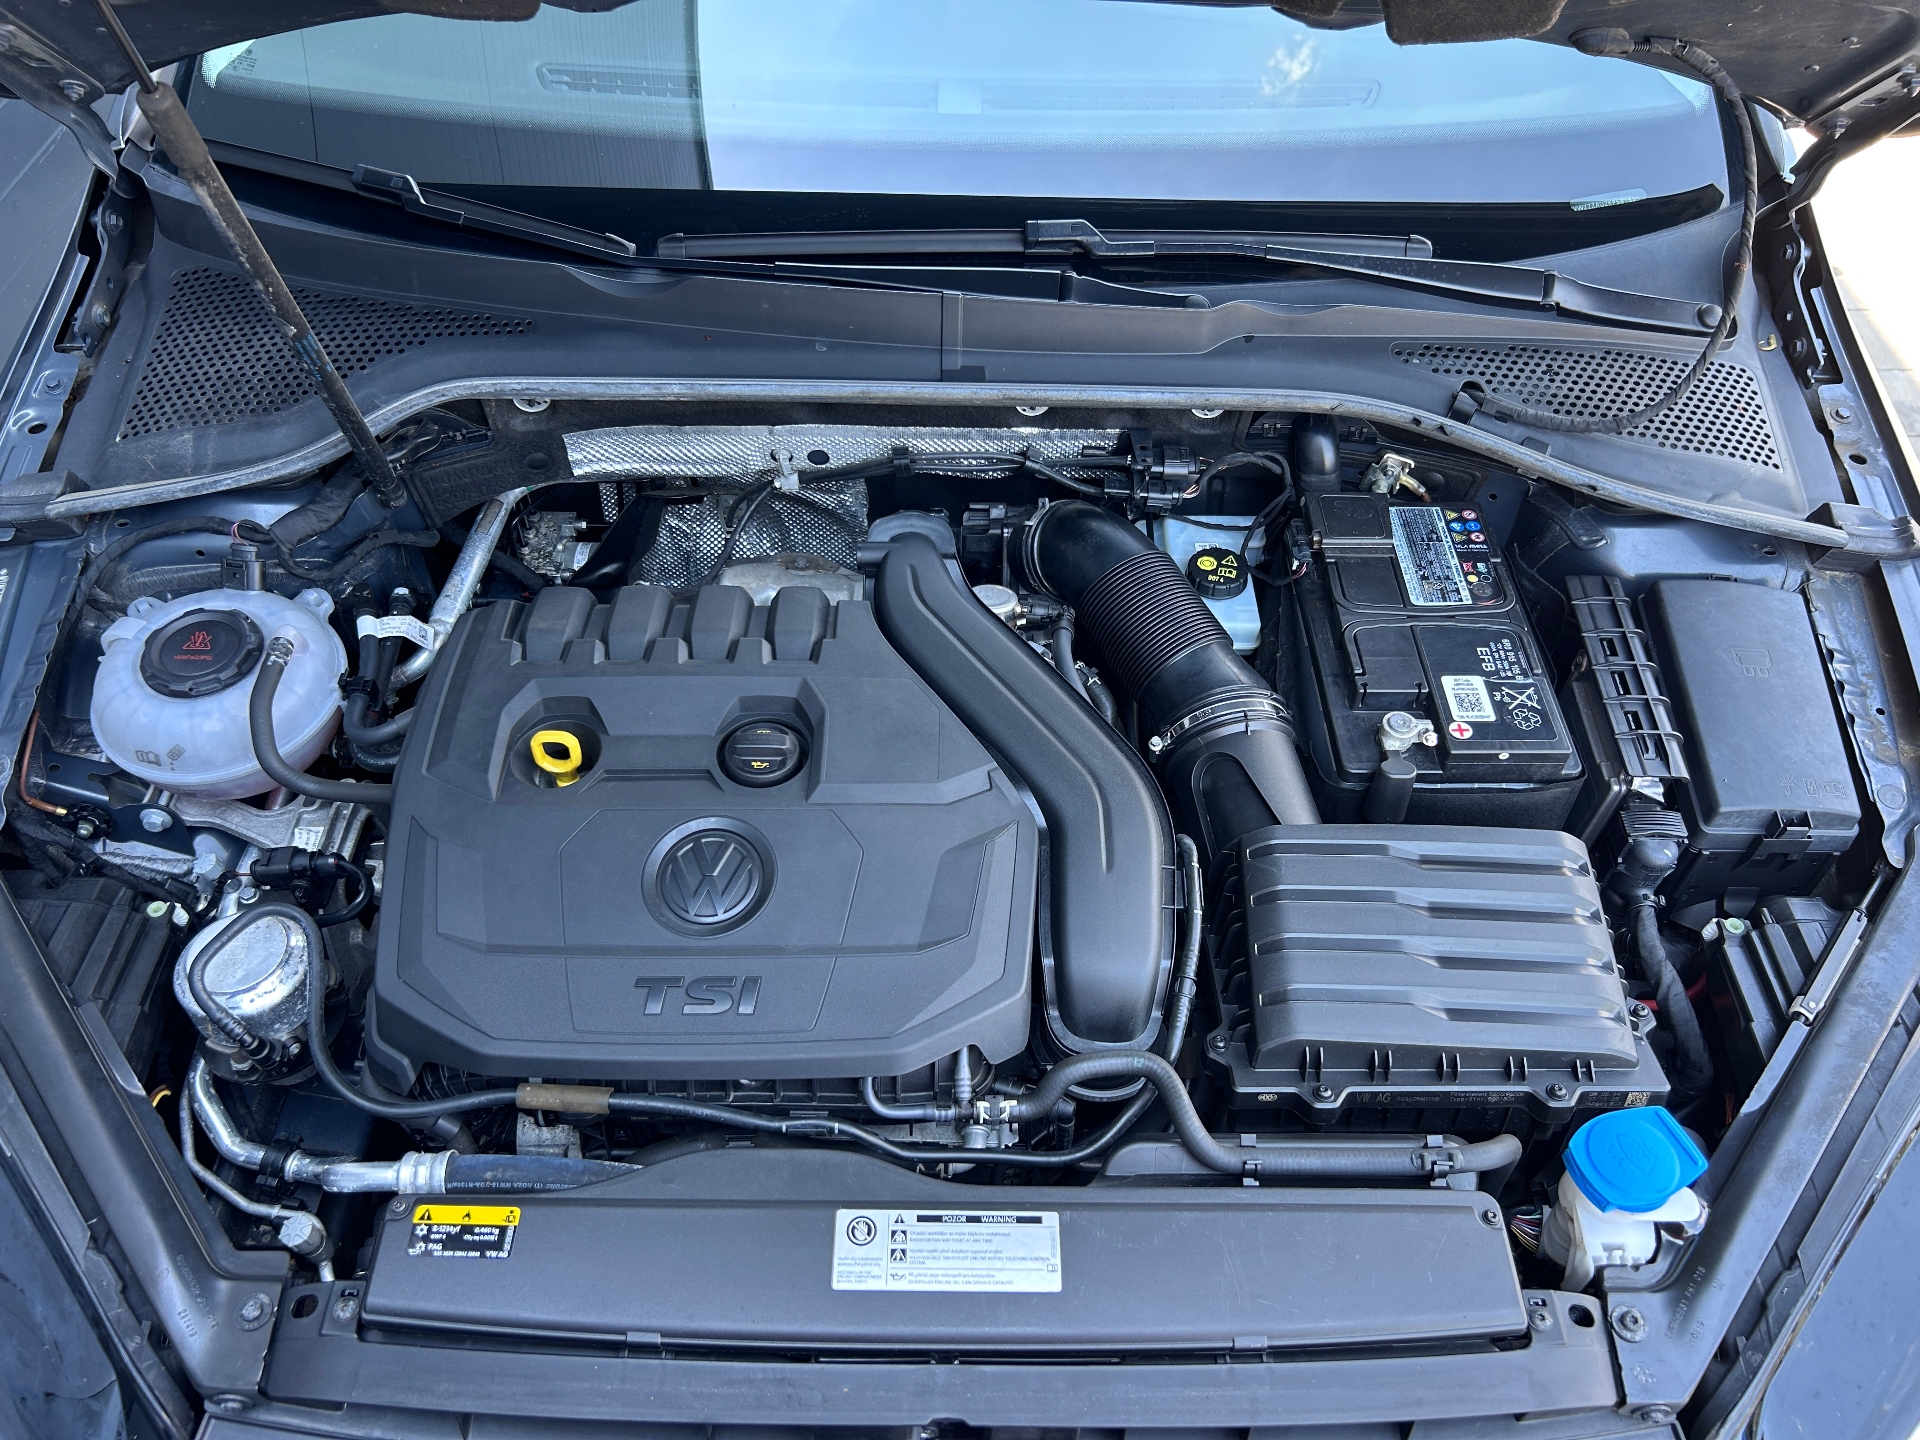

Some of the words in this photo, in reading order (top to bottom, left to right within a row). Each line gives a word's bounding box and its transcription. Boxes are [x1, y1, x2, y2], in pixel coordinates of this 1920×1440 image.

[1477, 647, 1495, 671] EFB
[1492, 691, 1502, 701] Pb
[634, 975, 763, 1015] TSI
[1356, 1093, 1371, 1102] VW
[1375, 1093, 1391, 1102] AG
[942, 1215, 967, 1223] POZOR
[485, 1250, 498, 1258] VW
